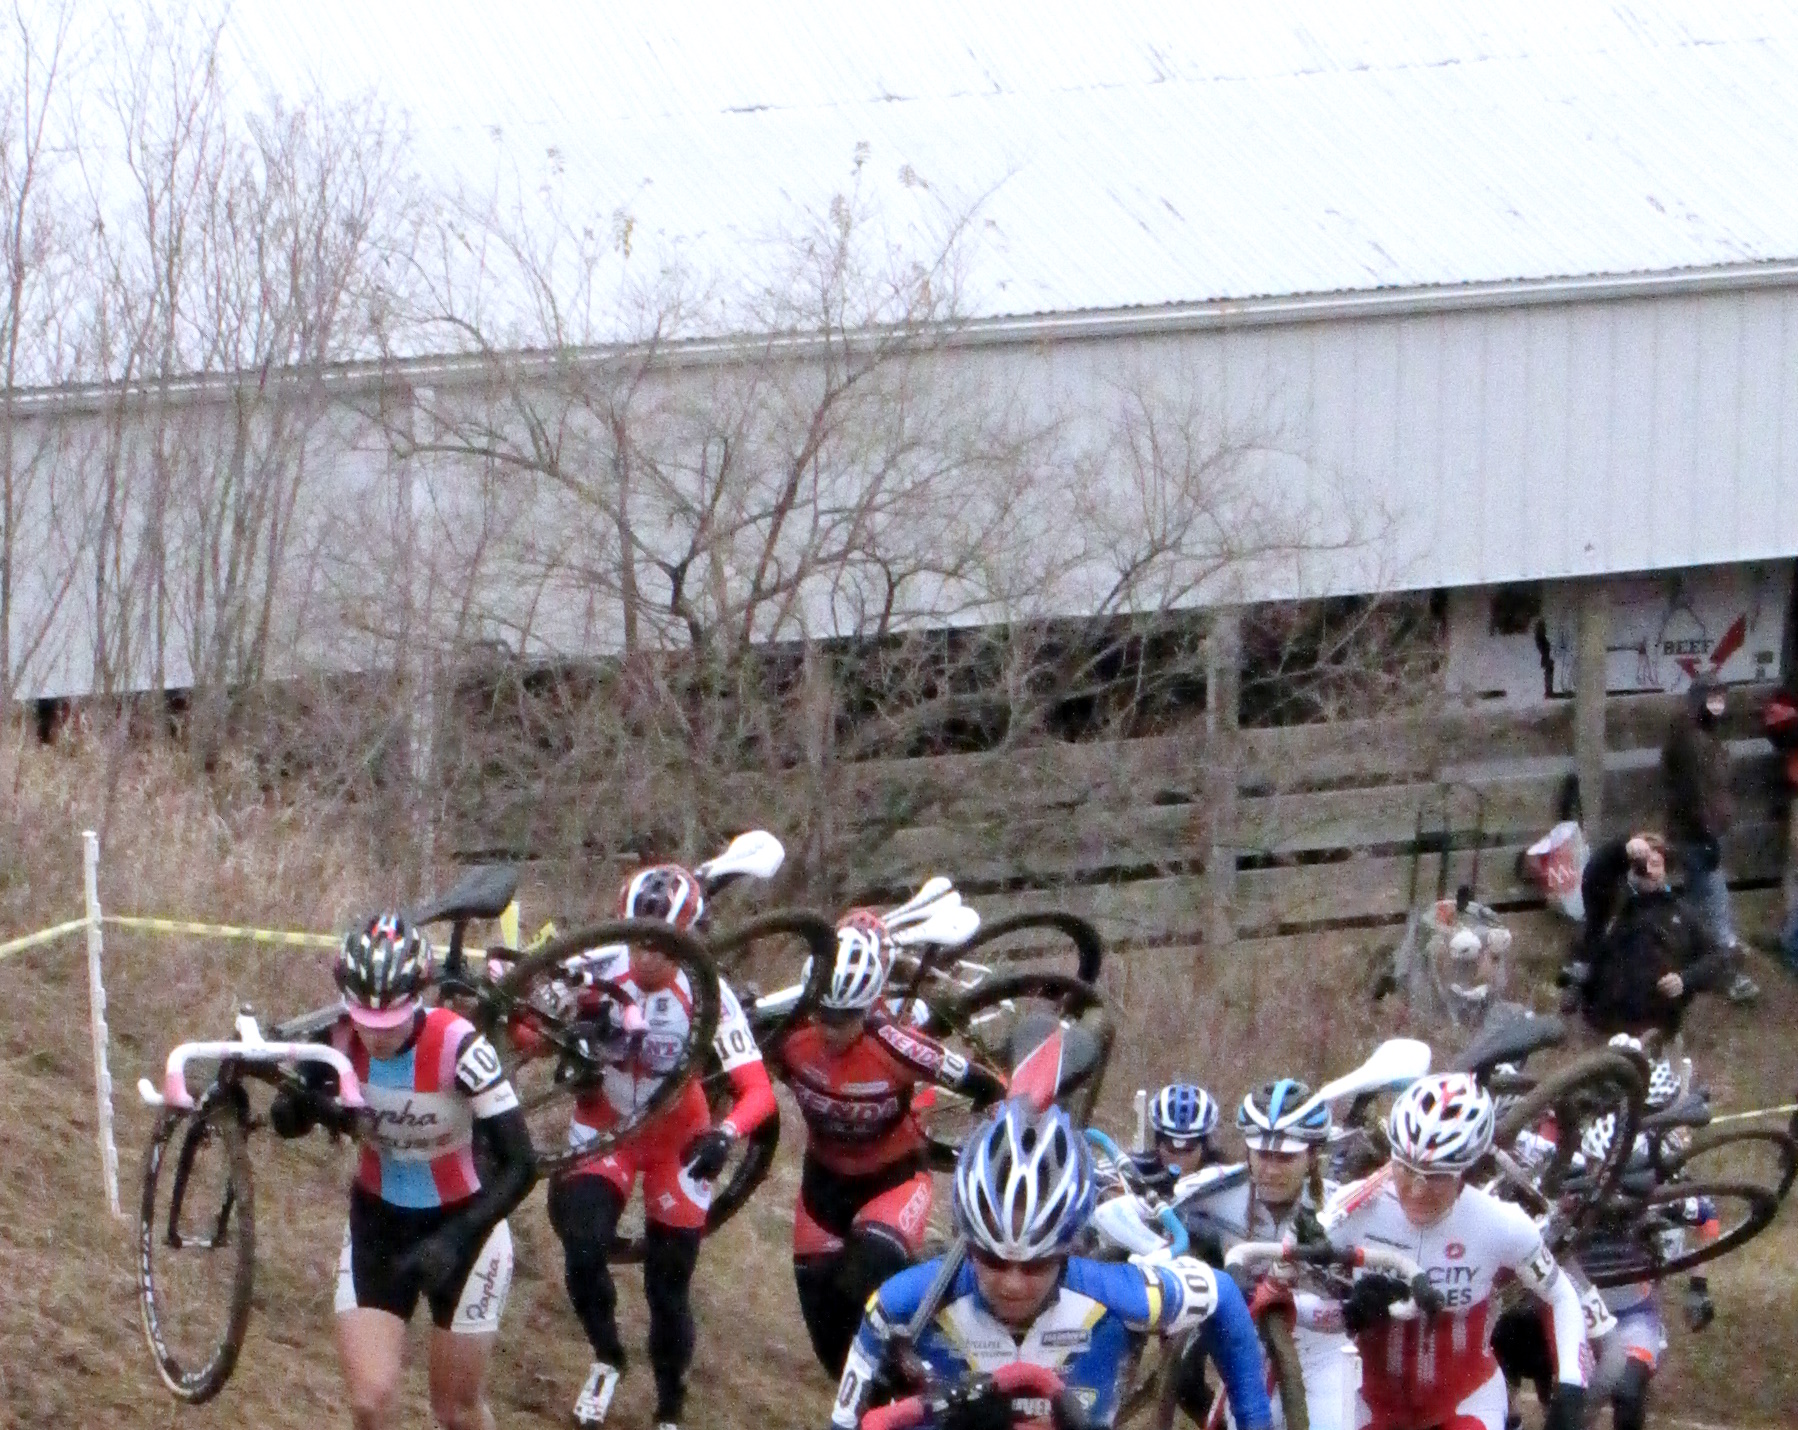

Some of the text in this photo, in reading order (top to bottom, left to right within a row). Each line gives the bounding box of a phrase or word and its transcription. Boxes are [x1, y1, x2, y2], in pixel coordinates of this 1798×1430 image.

[458, 1040, 499, 1087] 10
[466, 1254, 500, 1320] Rapha
[1426, 1266, 1481, 1284] CITY
